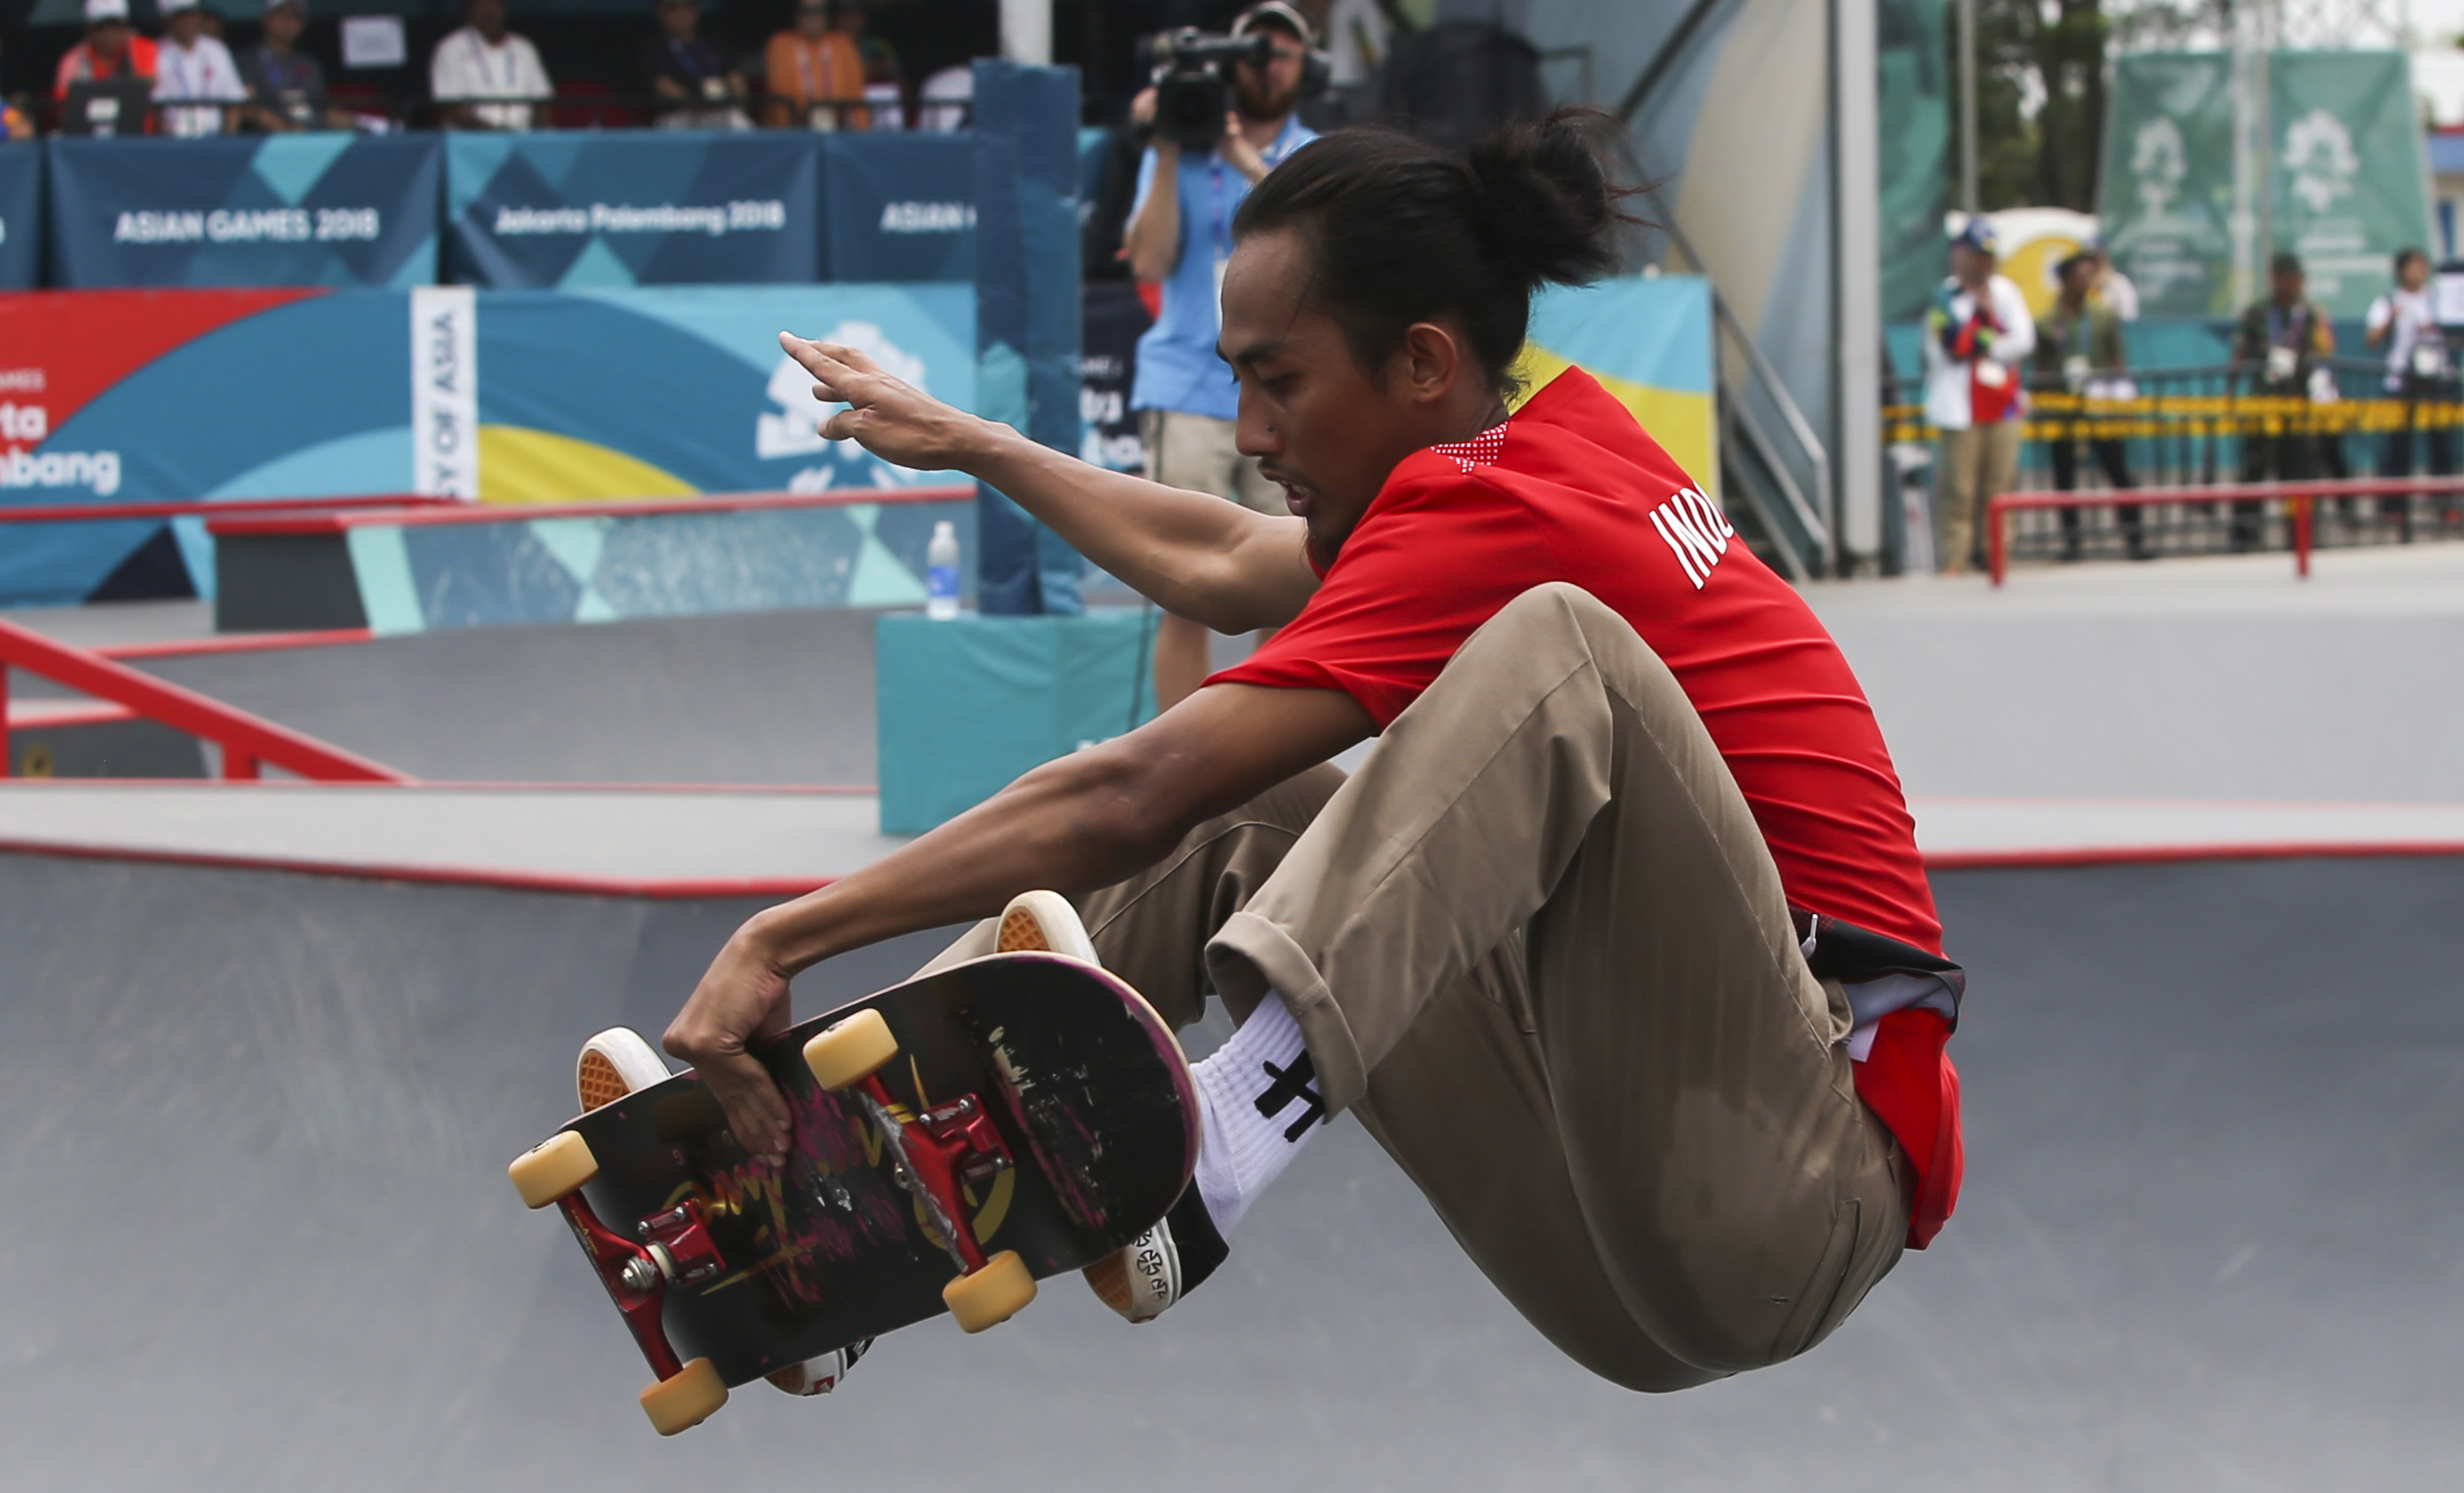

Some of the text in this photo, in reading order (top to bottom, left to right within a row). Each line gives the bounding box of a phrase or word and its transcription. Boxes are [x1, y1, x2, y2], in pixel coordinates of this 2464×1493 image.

[113, 208, 380, 243] ASIAN GAMES 2018
[495, 200, 785, 237] Jakarta Palembang 2018
[880, 201, 963, 233] ASIAN
[431, 312, 457, 392] ASIA
